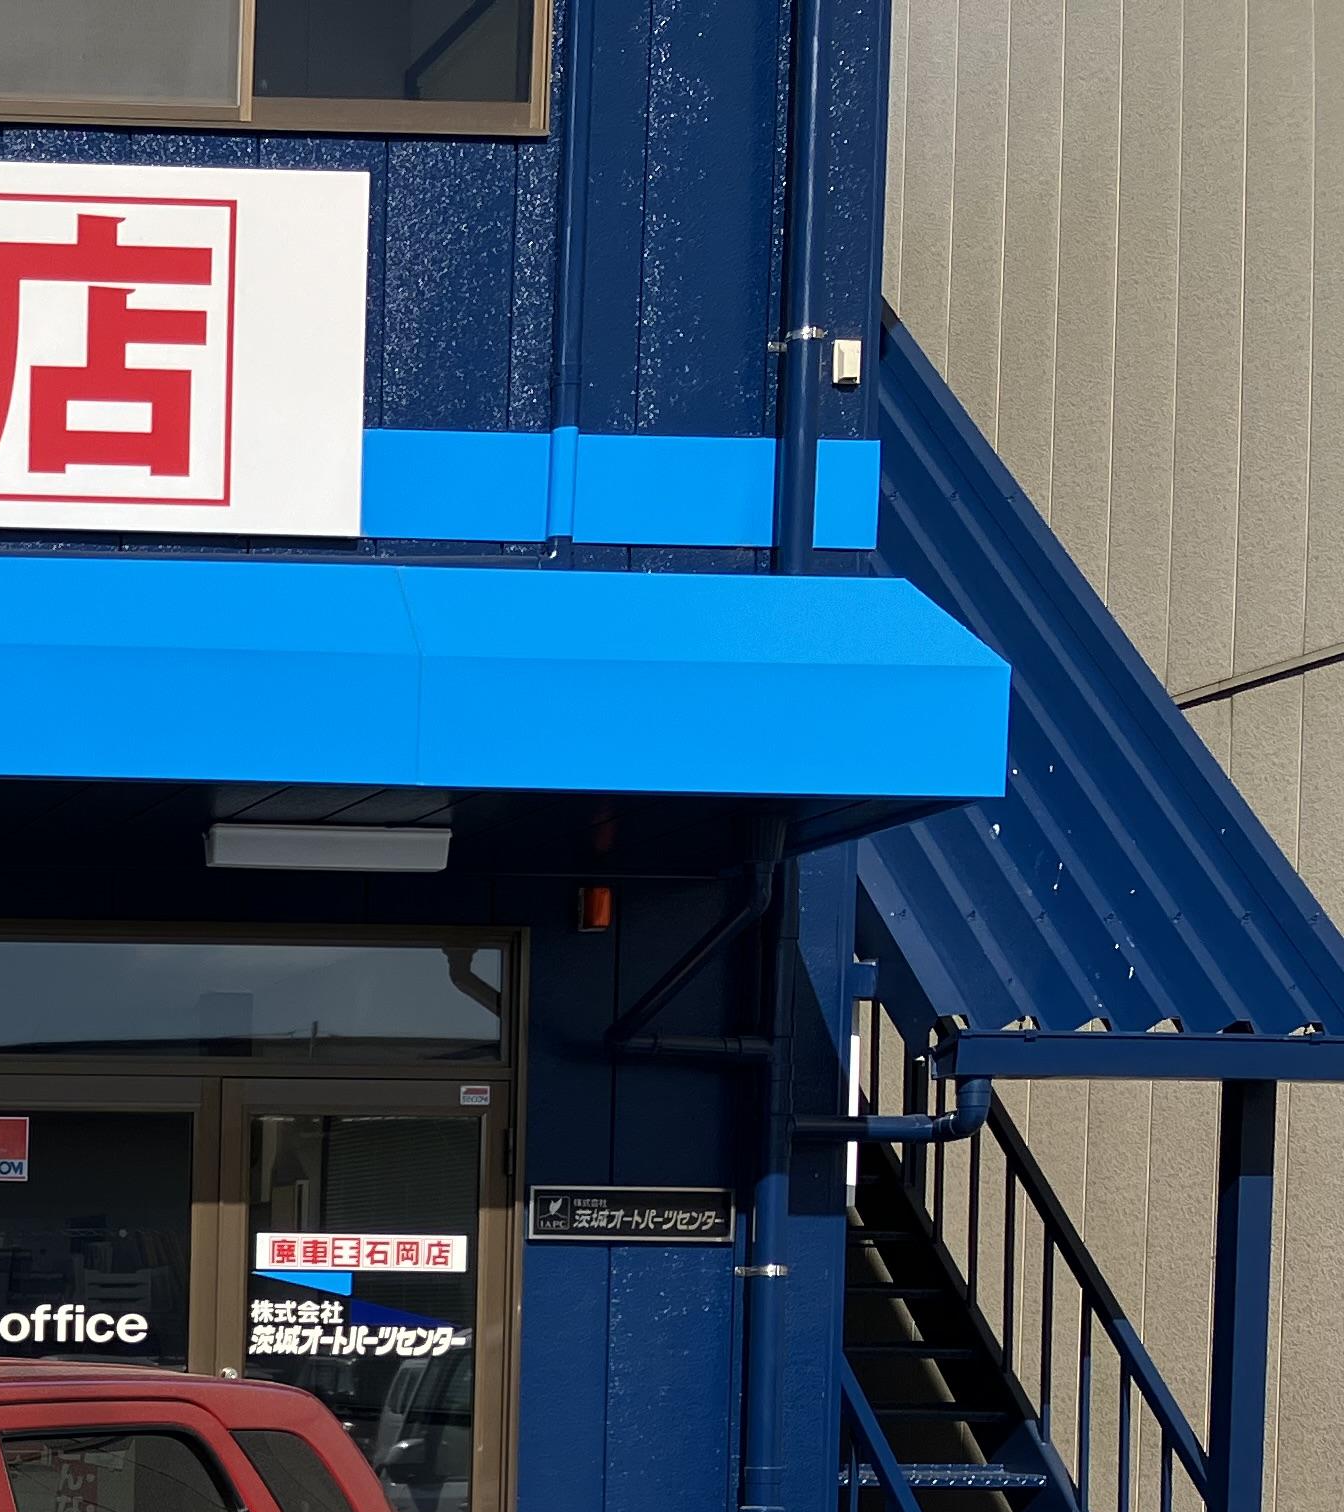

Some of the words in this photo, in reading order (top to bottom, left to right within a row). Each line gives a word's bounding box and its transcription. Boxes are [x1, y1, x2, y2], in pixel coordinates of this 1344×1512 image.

[573, 1209, 725, 1231] 茨城オートパーツセンター
[271, 1237, 451, 1267] 廃車王石岡店
[250, 1299, 345, 1324] 株式会社
[248, 1325, 467, 1357] 茨城オートパーツセンター
